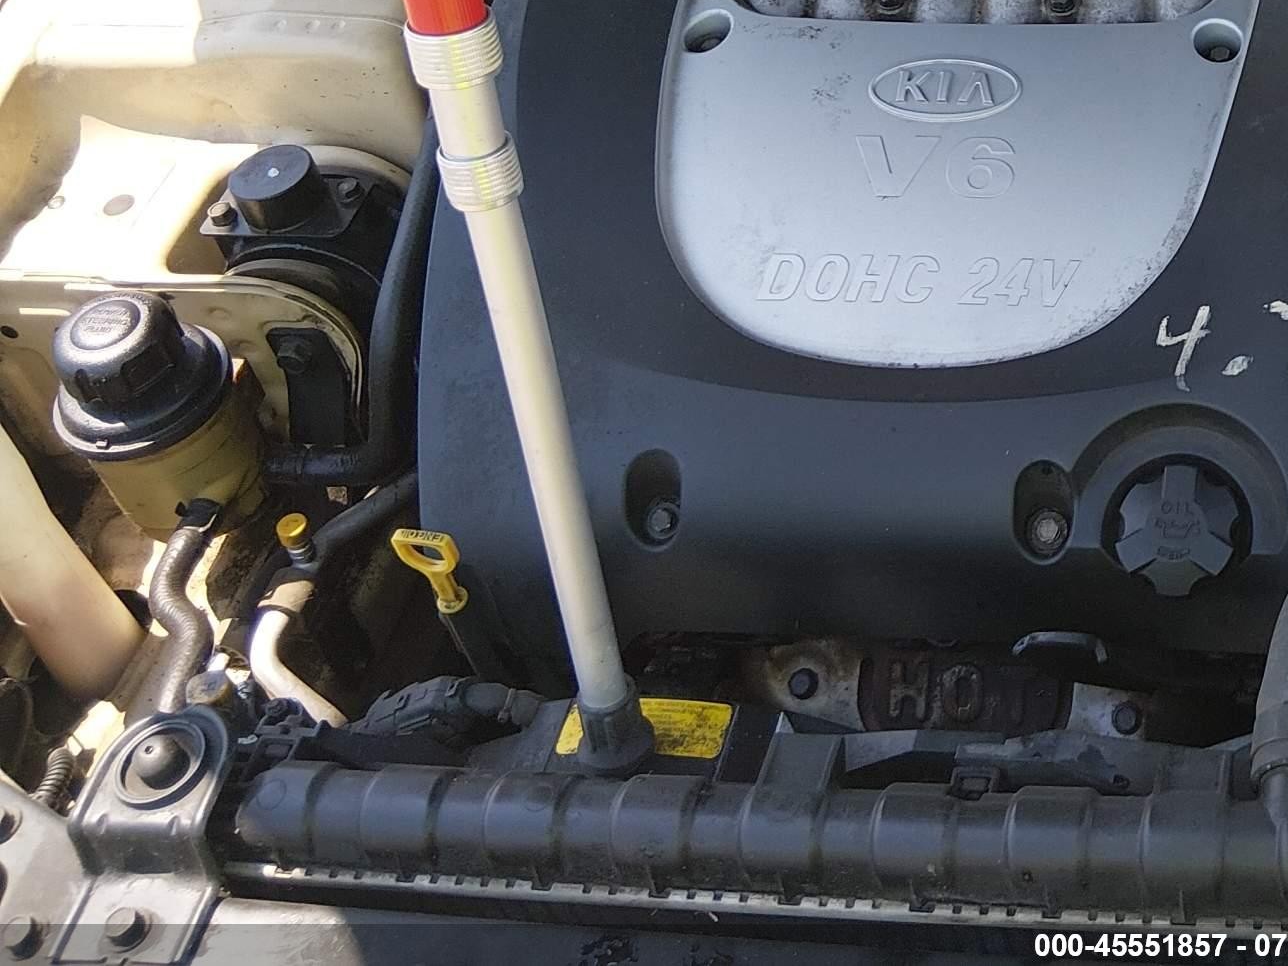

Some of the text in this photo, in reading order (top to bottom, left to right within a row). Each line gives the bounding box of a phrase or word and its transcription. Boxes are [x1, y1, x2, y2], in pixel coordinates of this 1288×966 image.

[895, 69, 995, 105] KIA
[855, 135, 1016, 198] V6
[756, 253, 1082, 308] DOHC 24V
[1160, 500, 1194, 515] OIL
